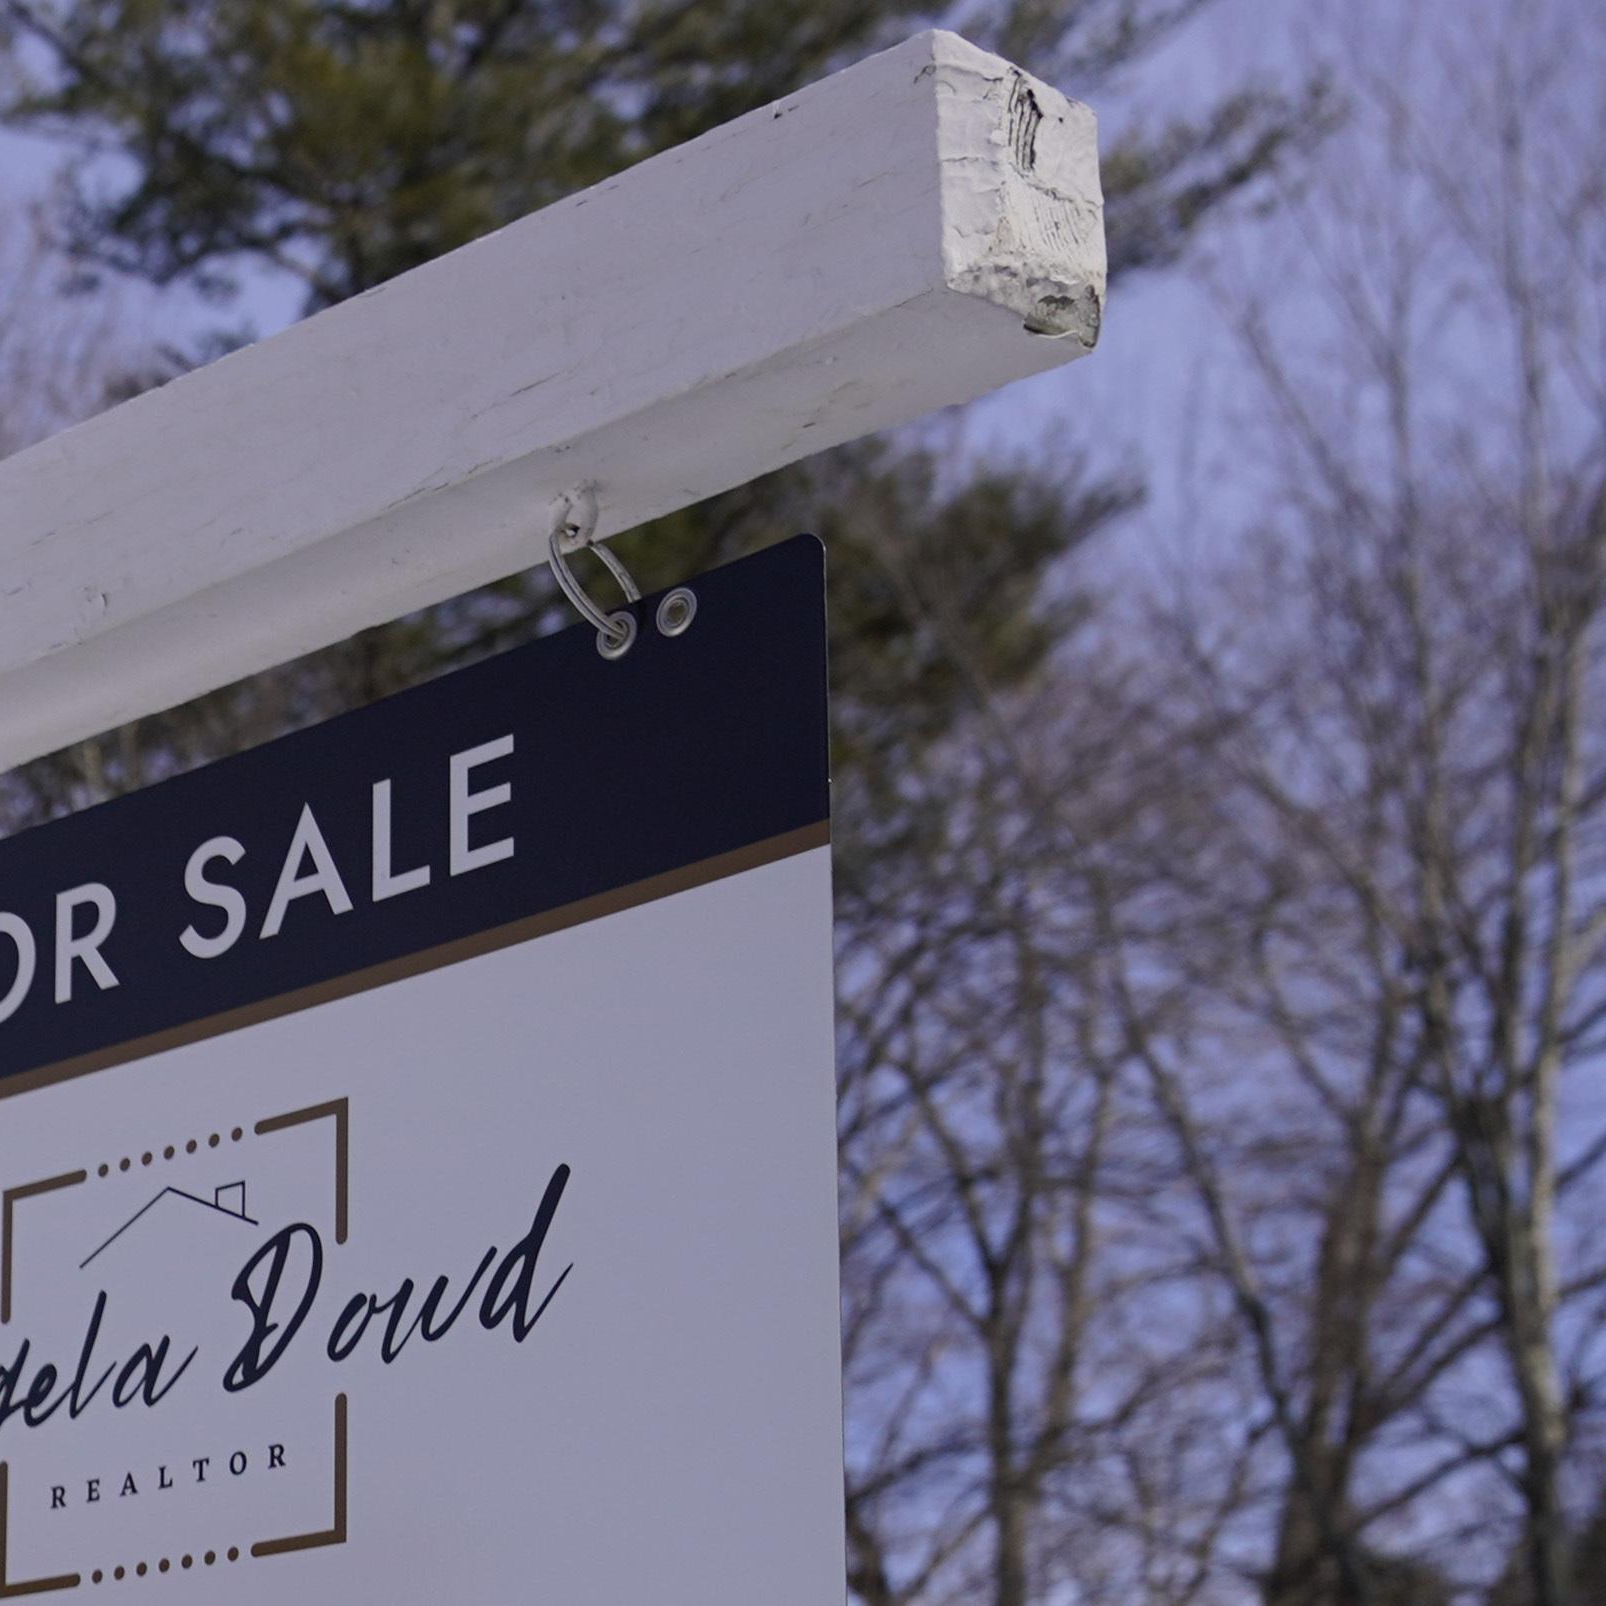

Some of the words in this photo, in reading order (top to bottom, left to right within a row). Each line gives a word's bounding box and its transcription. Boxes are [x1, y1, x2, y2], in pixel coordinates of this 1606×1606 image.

[179, 733, 515, 959] SALE
[222, 1163, 574, 1393] Dowd
[50, 1443, 287, 1509] REALTOR
